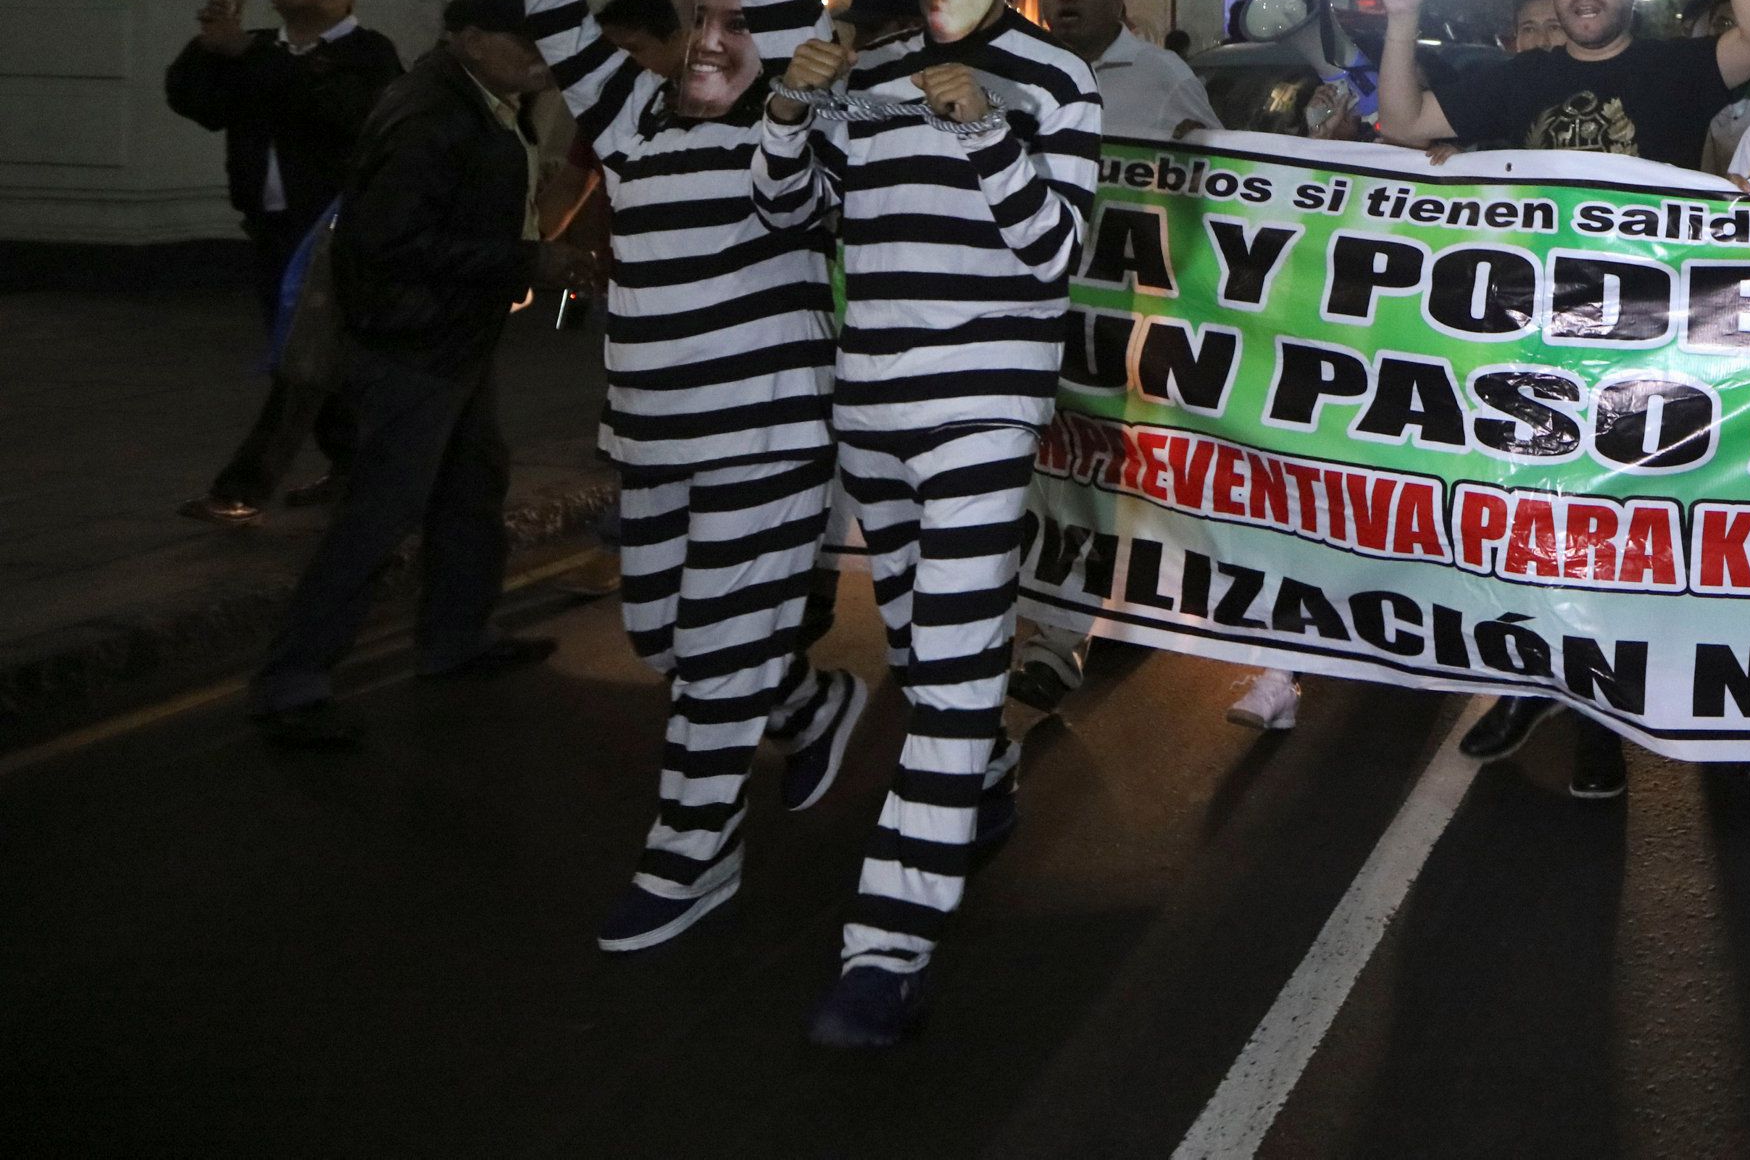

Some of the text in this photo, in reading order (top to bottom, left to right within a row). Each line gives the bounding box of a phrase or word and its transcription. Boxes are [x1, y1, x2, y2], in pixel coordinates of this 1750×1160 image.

[1098, 155, 1272, 203] ueblos
[1294, 179, 1348, 213] si
[1366, 185, 1555, 229] tienen
[1082, 207, 1176, 292] A
[1208, 218, 1299, 305] Y
[1269, 341, 1713, 468] PASO
[1075, 423, 1446, 558] PREVENTIVA
[1460, 490, 1678, 586] PARA
